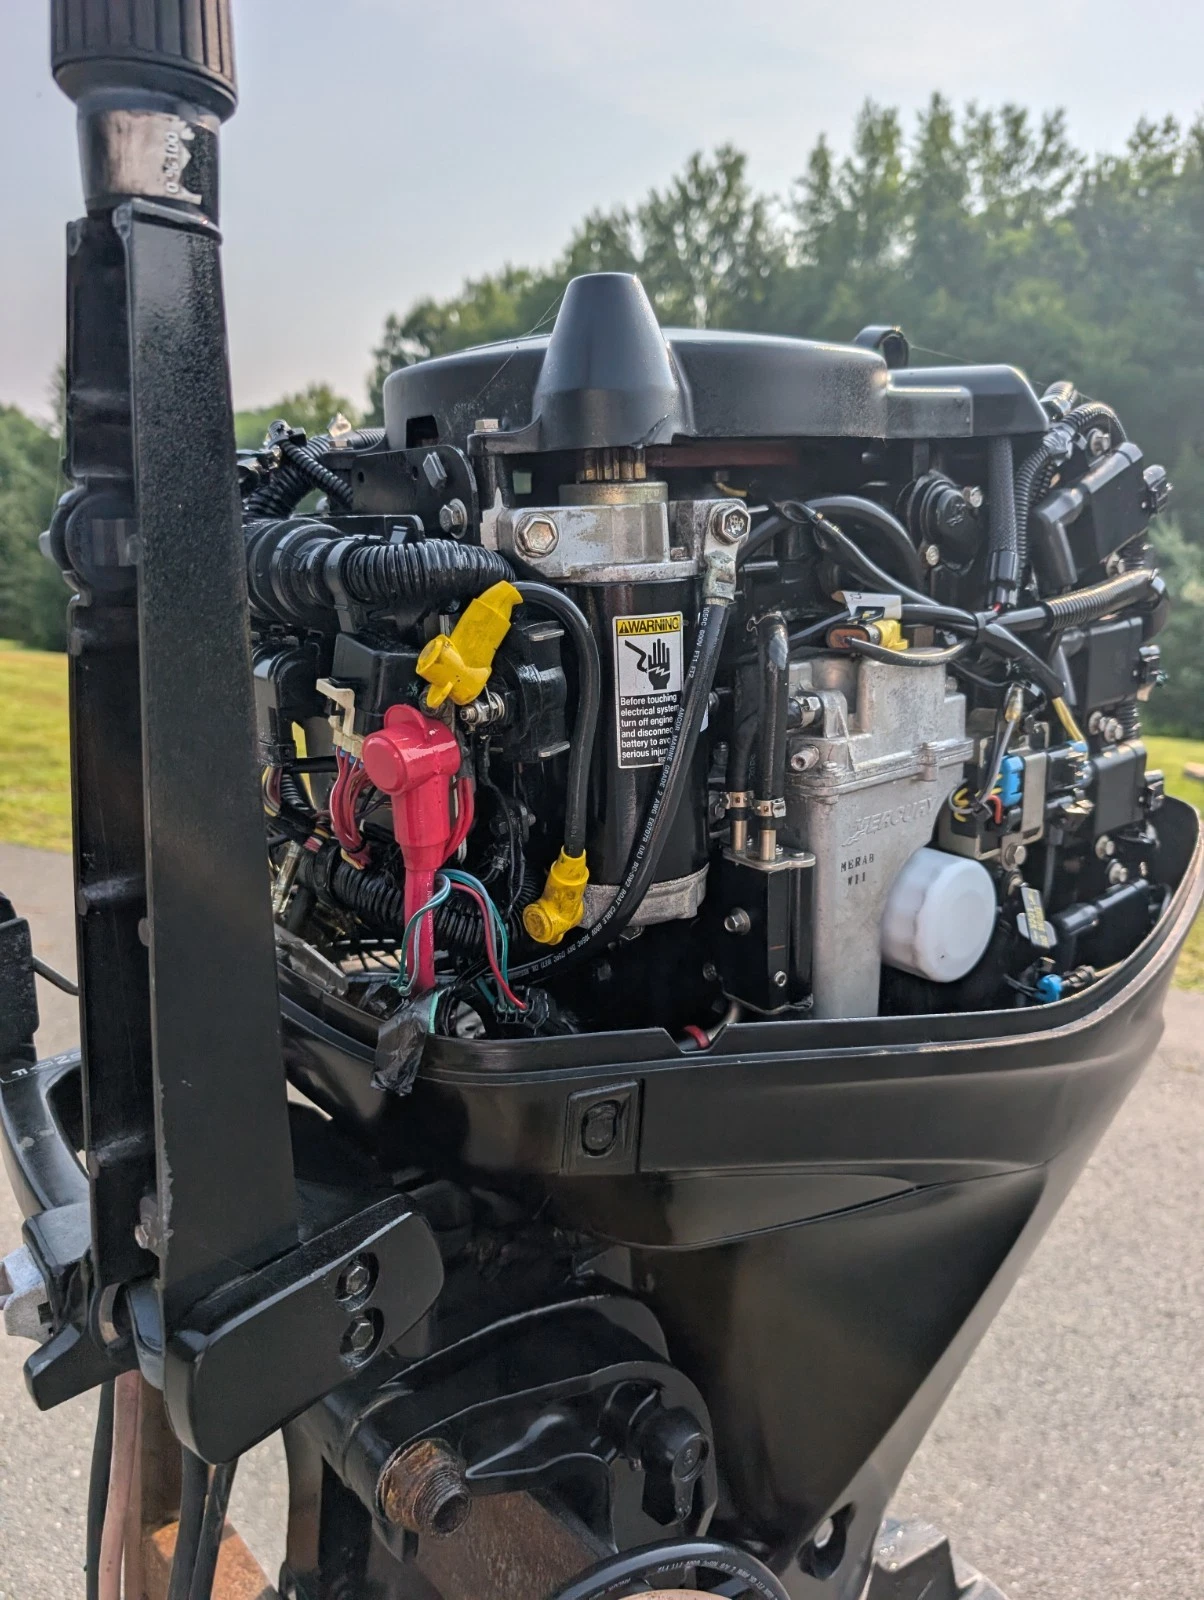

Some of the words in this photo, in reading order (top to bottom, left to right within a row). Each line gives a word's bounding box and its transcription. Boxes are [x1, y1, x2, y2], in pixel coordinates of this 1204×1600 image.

[627, 616, 679, 634] WARNING
[692, 650, 701, 662] FT1
[688, 665, 697, 679] FT2
[620, 696, 646, 706] Before
[647, 693, 677, 704] touching
[620, 705, 656, 717] electrical
[656, 704, 679, 716] system
[620, 719, 637, 728] turn
[638, 717, 649, 726] off
[650, 715, 674, 727] engine
[675, 707, 685, 731] ANCOR
[621, 729, 636, 738] and
[637, 726, 674, 738] disconnec
[621, 739, 649, 749] battery
[649, 738, 658, 746] to
[658, 737, 671, 745] avo
[666, 734, 678, 762] MARINE
[621, 749, 650, 759] serious
[651, 747, 668, 757] injur
[659, 764, 670, 788] GRADE
[651, 797, 661, 815] AWG
[636, 844, 646, 859] (UL)
[615, 888, 627, 906] BOAT
[602, 905, 616, 925] CABLE
[11, 1068, 29, 1077] F
